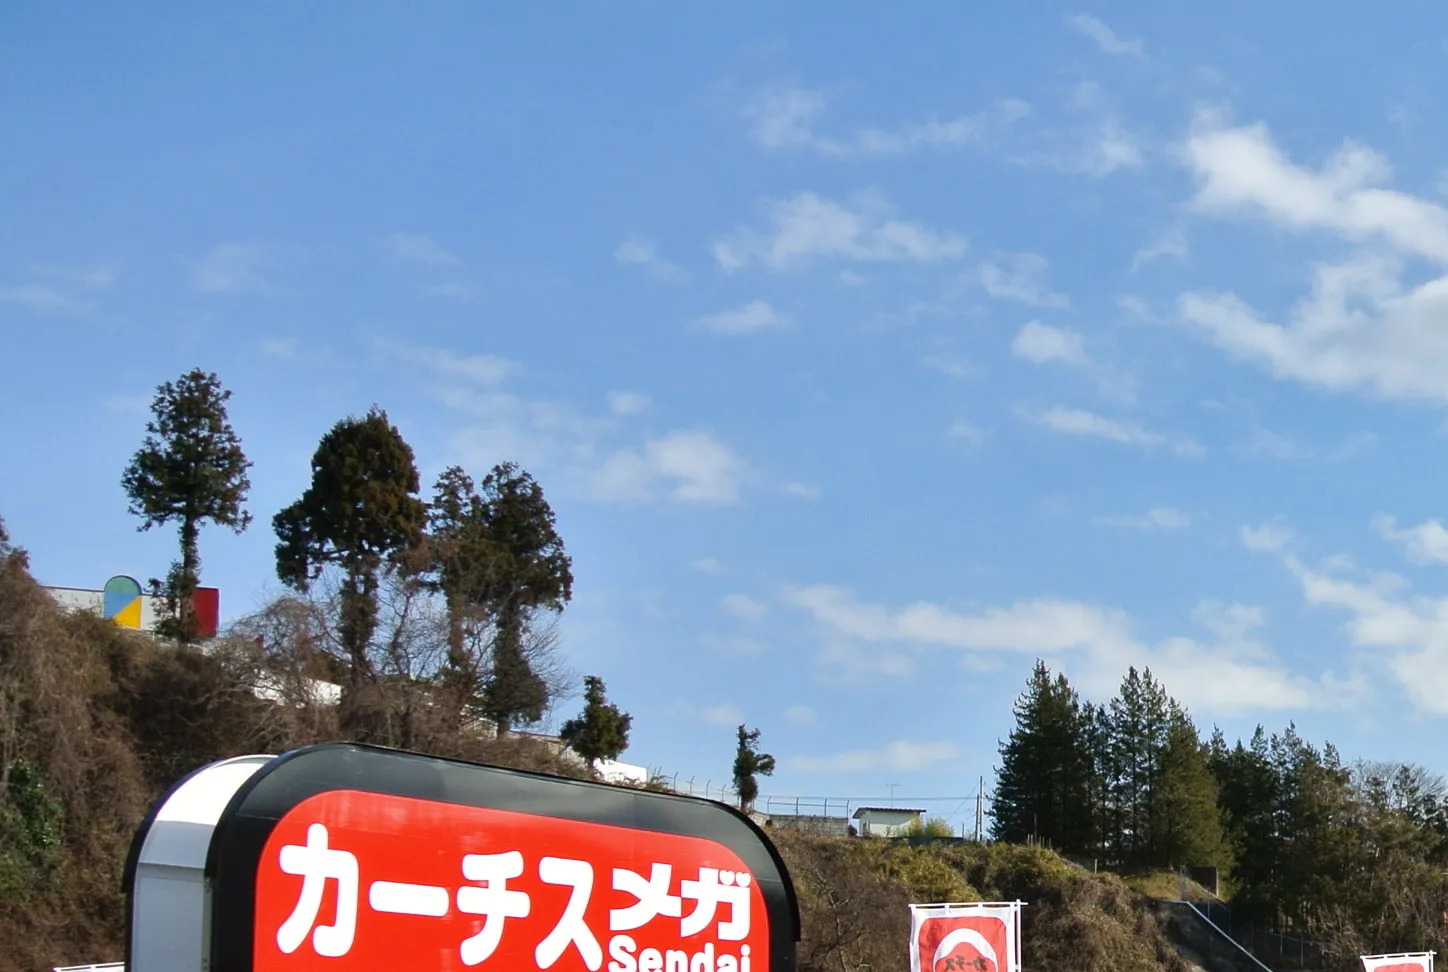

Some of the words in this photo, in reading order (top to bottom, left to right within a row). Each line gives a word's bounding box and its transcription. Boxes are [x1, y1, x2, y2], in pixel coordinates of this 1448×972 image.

[277, 823, 603, 972] カーチス
[609, 862, 751, 942] メガ
